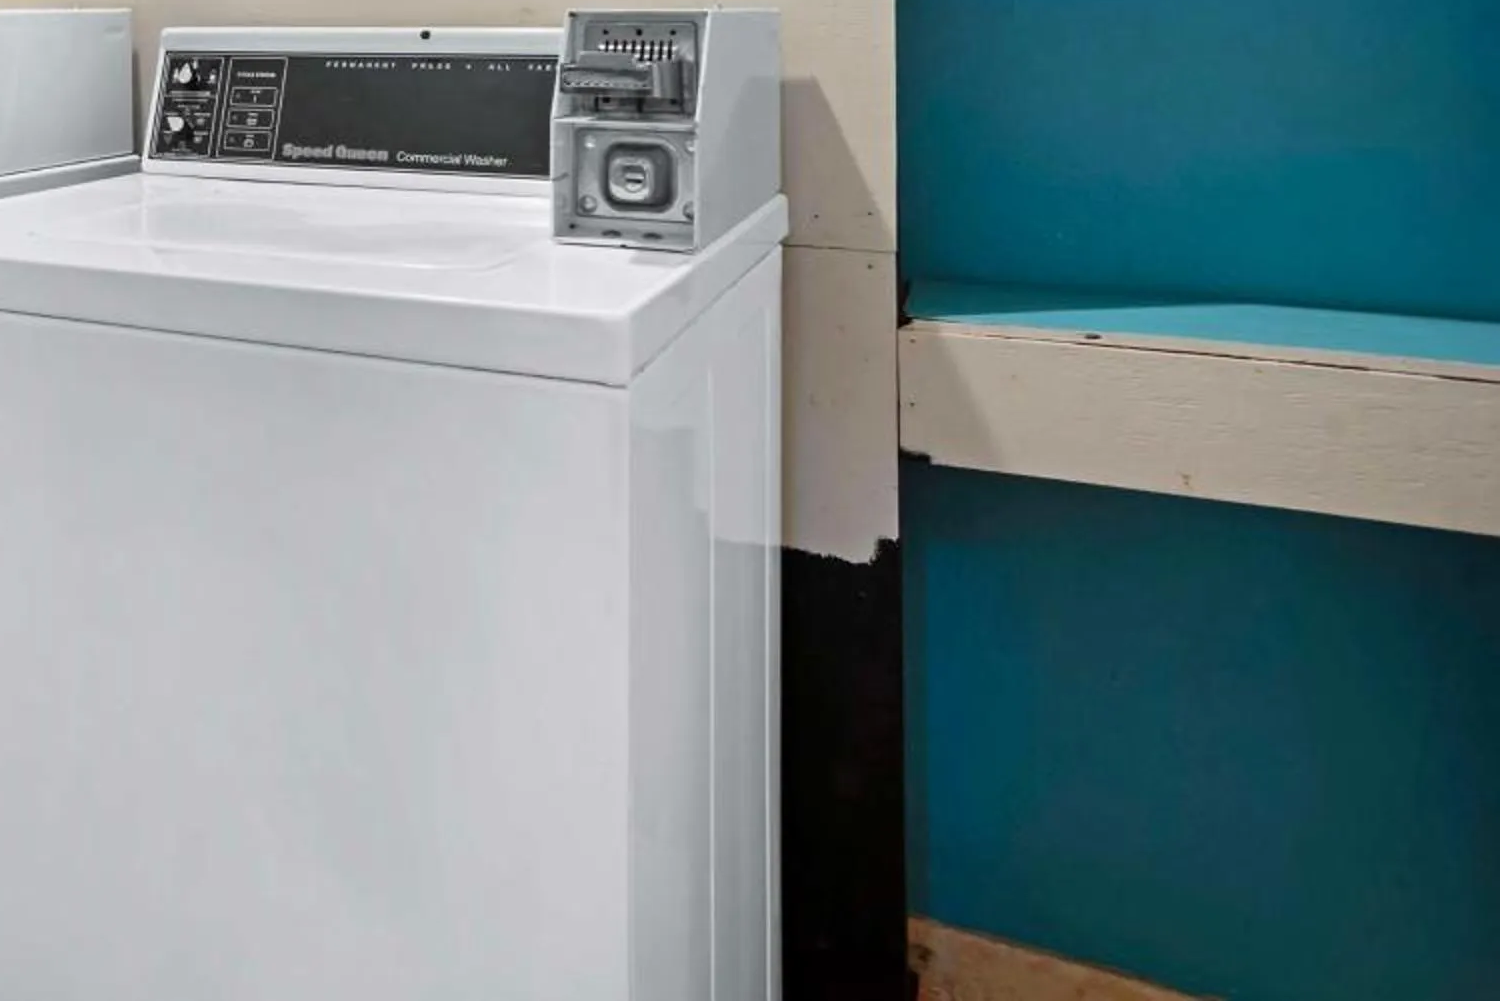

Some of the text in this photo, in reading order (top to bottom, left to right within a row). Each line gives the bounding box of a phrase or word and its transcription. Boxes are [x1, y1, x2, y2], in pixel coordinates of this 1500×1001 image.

[282, 143, 334, 160] Speed
[396, 150, 461, 166] Commercial
[463, 153, 508, 167] Washer
